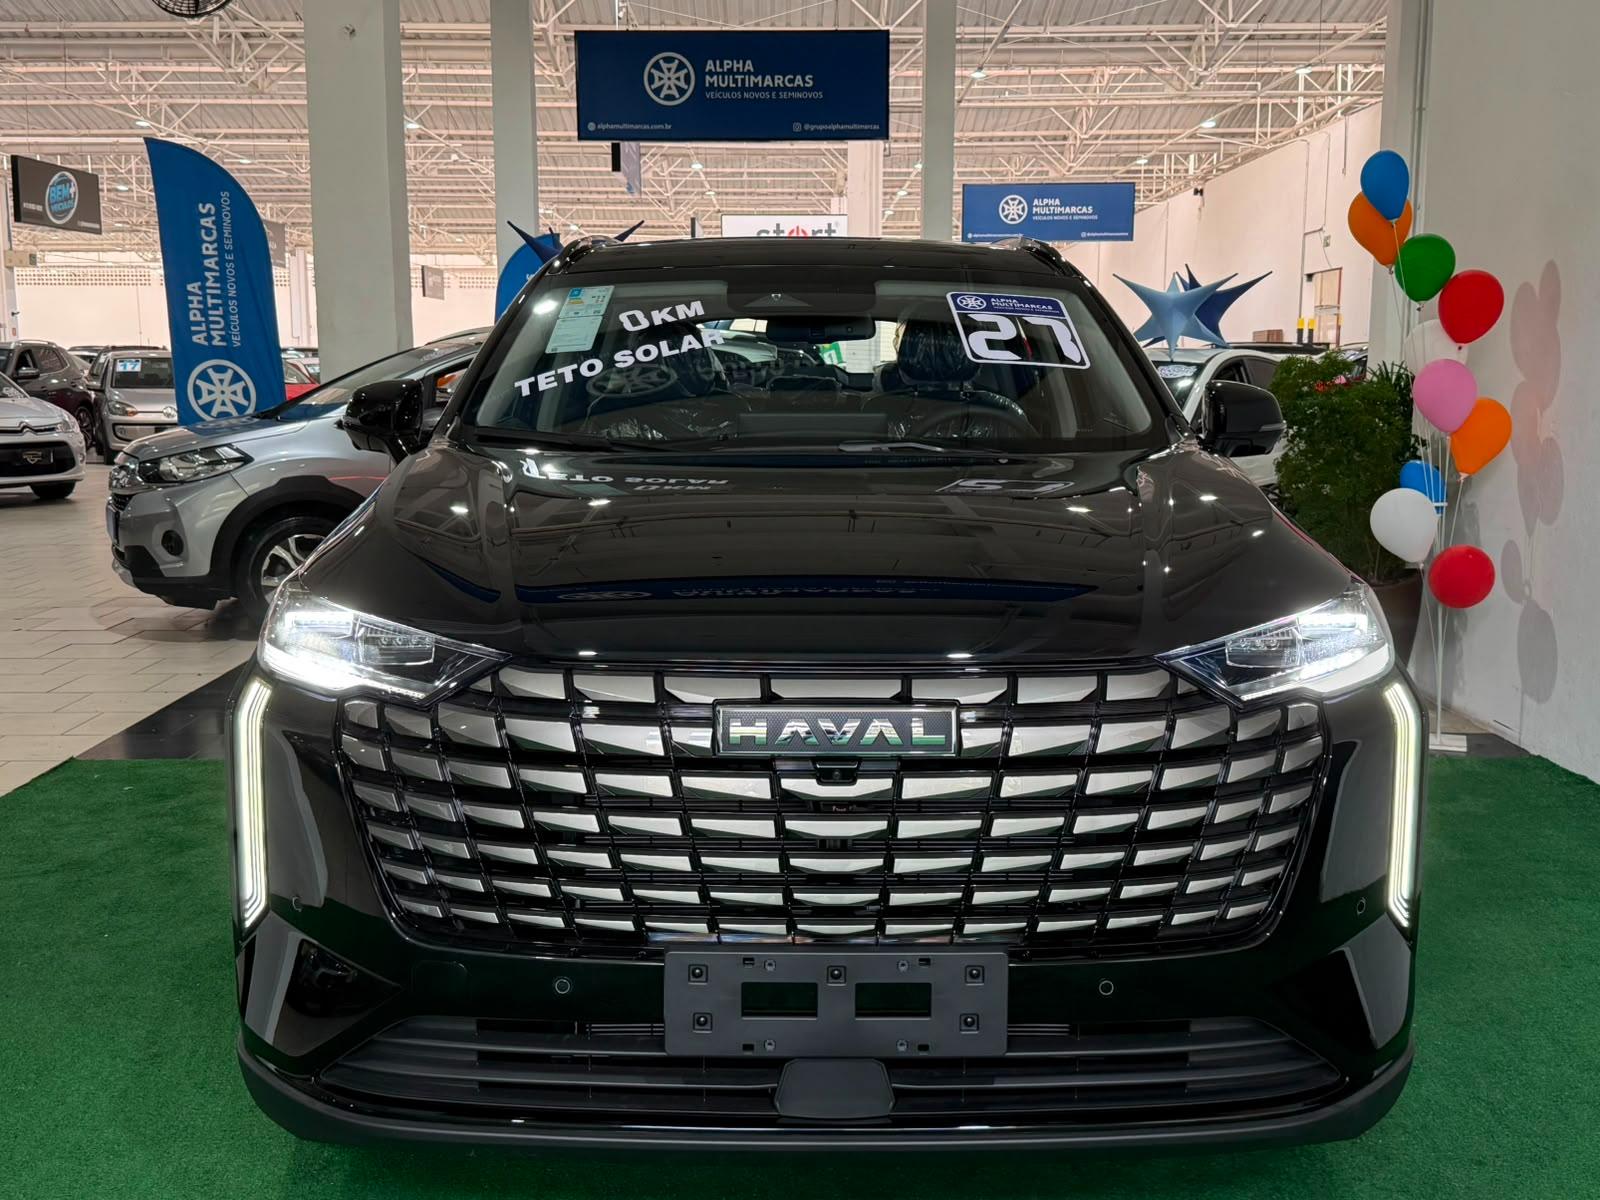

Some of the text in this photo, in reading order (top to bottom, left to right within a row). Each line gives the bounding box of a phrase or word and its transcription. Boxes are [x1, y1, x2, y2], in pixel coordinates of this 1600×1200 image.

[705, 59, 754, 72] ALPHA
[705, 75, 814, 88] MULTIMARCAS
[705, 90, 824, 99] VEÍCULOS NOVOS E SEMINOVOS
[1032, 198, 1060, 206] ALPHA
[1032, 206, 1093, 214] MULTIMARCAS
[198, 202, 228, 347] MULTIMARCAS
[220, 191, 241, 348] VEÍCULOS NOVOS E SEMINOVOS
[186, 281, 209, 346] ALPHA
[619, 300, 706, 332] 0KM
[991, 301, 1053, 310] MULTIMARCAS
[967, 314, 1082, 363] 27
[514, 358, 604, 397] TETO
[613, 329, 725, 368] SOLAR
[729, 717, 946, 746] HAVAL
